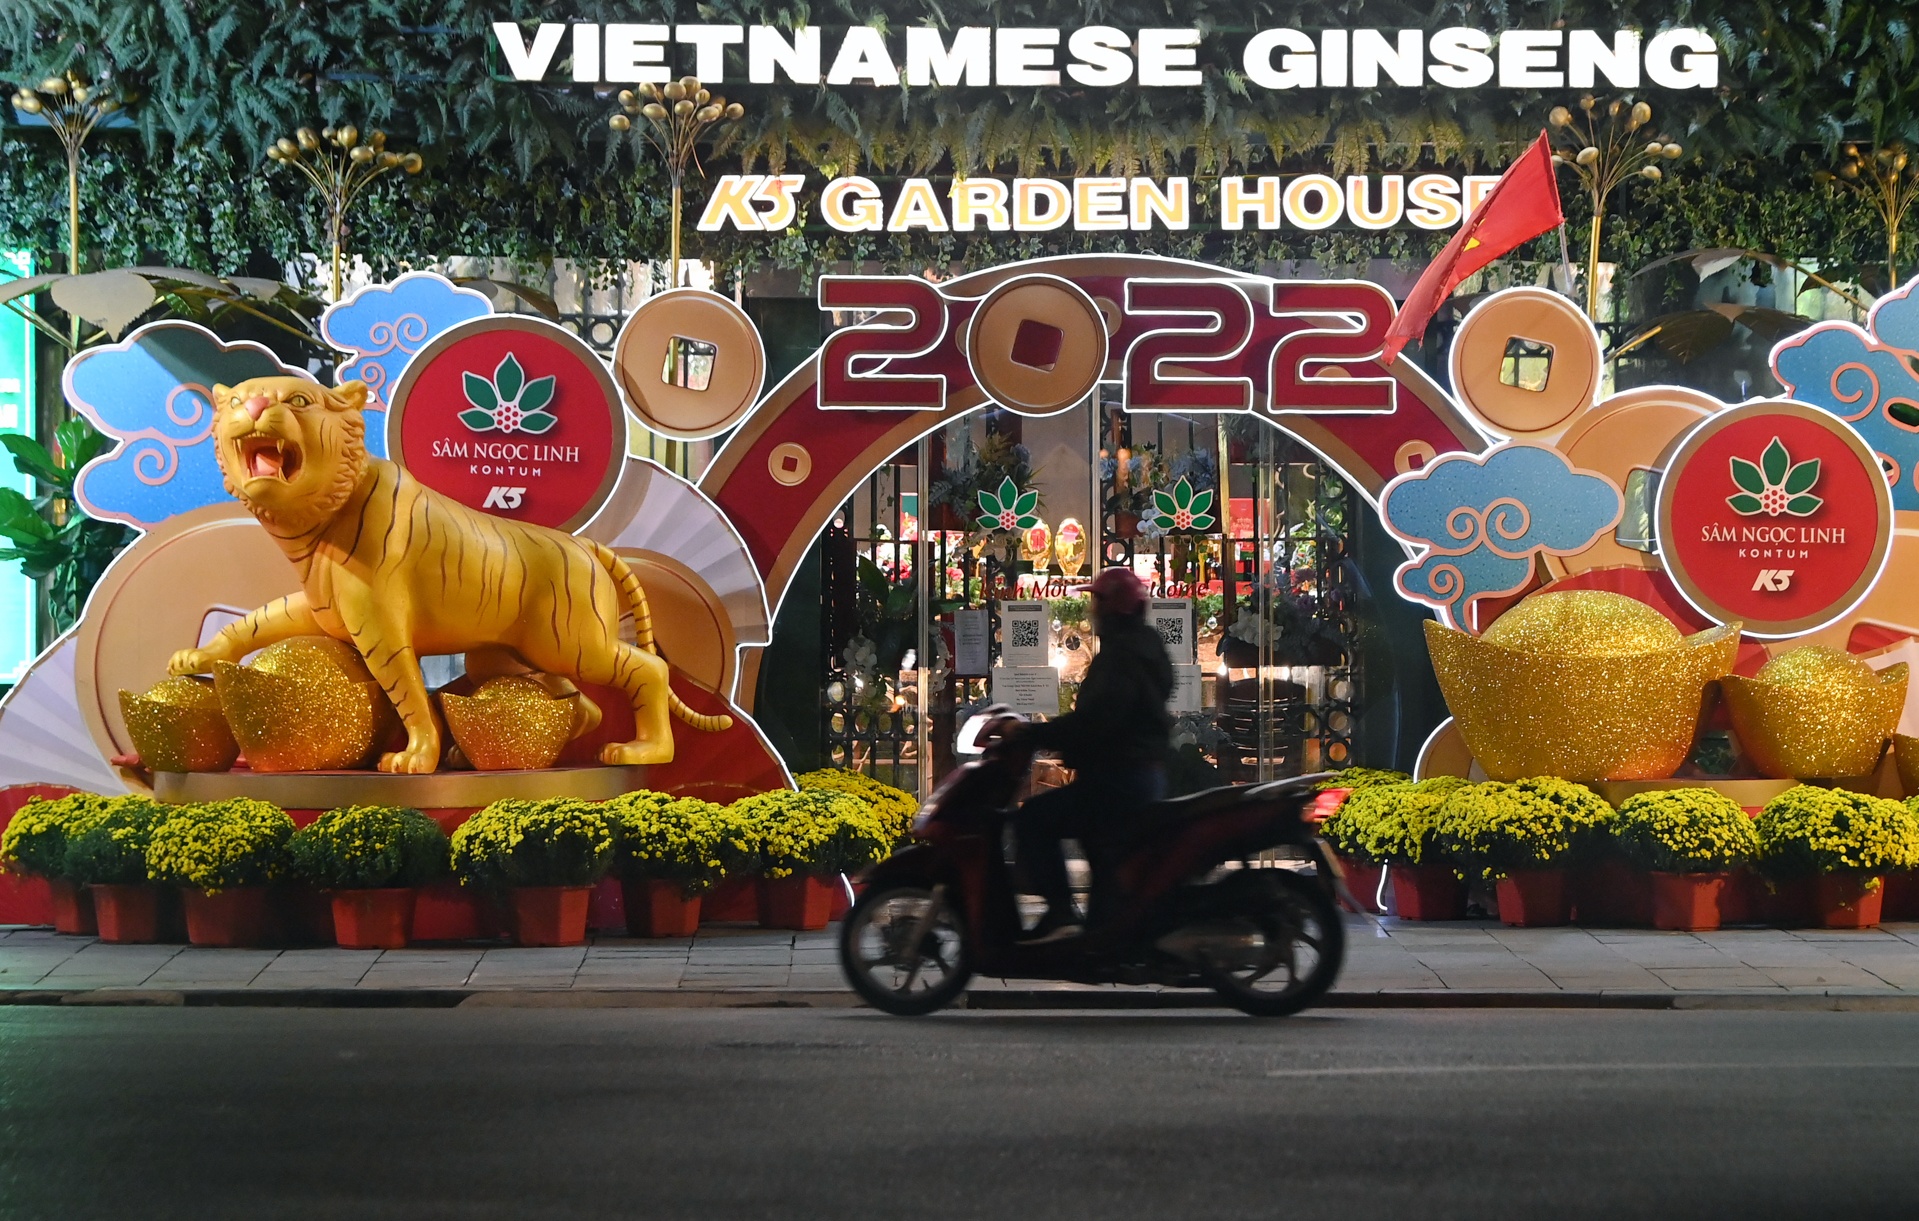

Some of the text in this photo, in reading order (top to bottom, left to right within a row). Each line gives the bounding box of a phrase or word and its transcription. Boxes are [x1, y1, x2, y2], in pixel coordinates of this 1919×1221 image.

[492, 22, 1720, 90] VIETNAMESE GINSENG
[696, 174, 805, 232] K5
[820, 176, 1190, 232] GARDEN
[817, 273, 1397, 418] 2022
[432, 437, 580, 463] SÂM NGỌC LINH
[470, 464, 541, 477] KONTUM
[482, 486, 527, 509] K5
[1701, 522, 1846, 546] SÂM NGỌC LINH
[1739, 548, 1809, 559] KONTUM
[1751, 569, 1795, 592] K5
